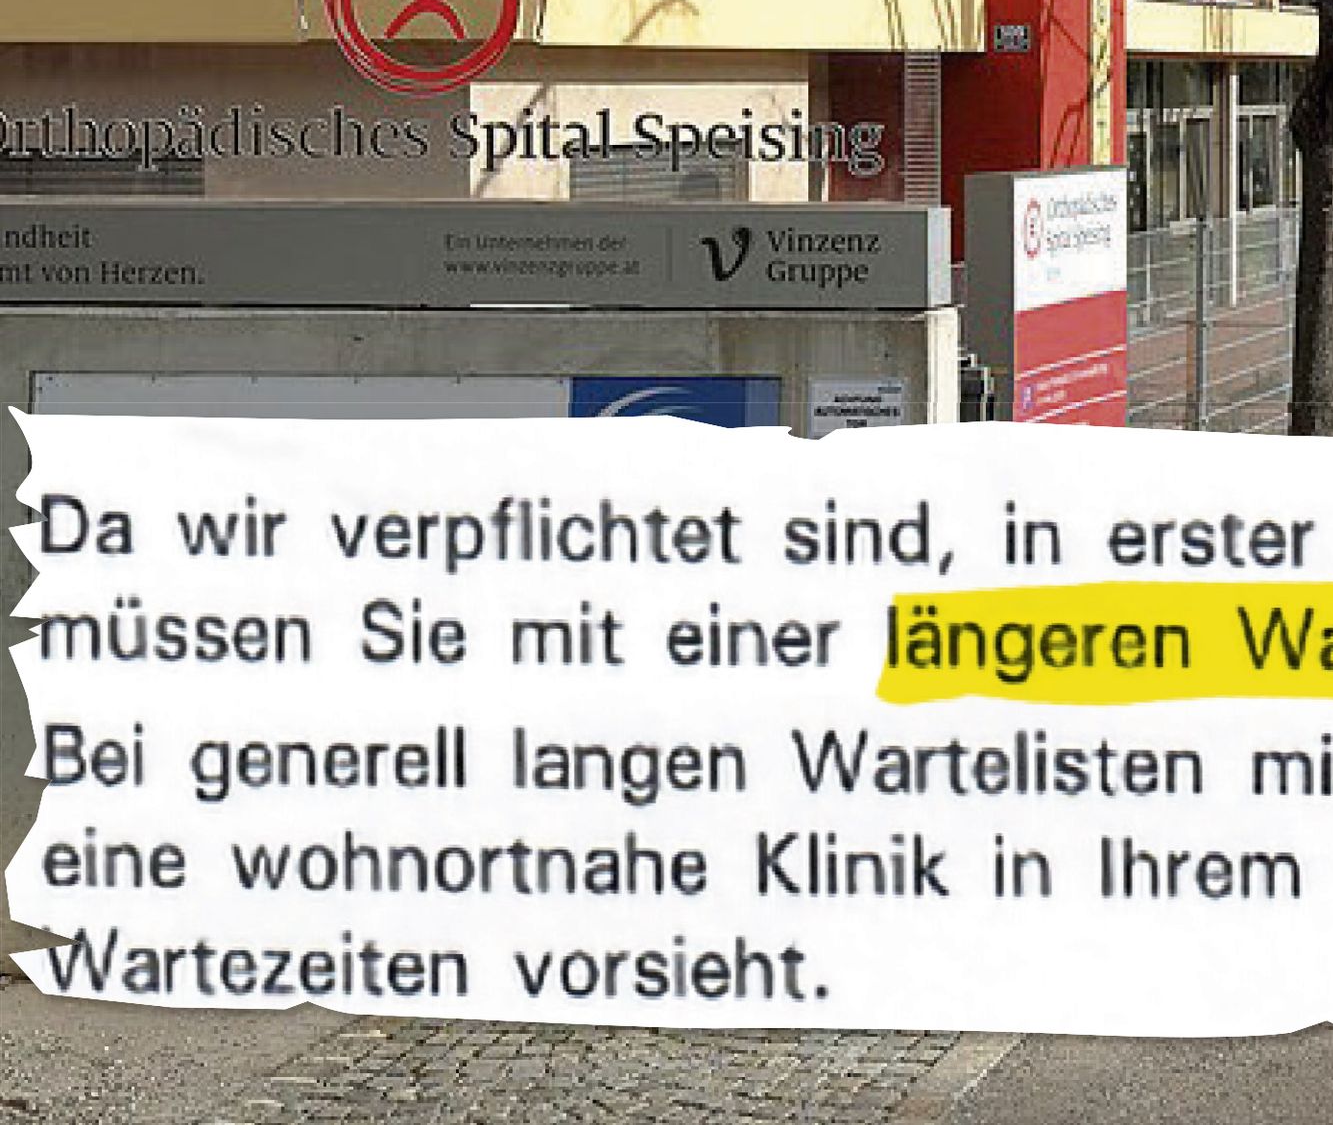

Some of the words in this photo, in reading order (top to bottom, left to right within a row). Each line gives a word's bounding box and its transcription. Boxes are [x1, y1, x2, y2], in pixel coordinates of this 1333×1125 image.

[0, 102, 431, 173] rthopädisches
[448, 107, 612, 172] Spital
[633, 107, 885, 175] Speising
[767, 228, 882, 254] Vinzenz
[40, 266, 91, 285] von
[101, 259, 206, 286] Herzen.
[766, 259, 871, 290] Gruppe
